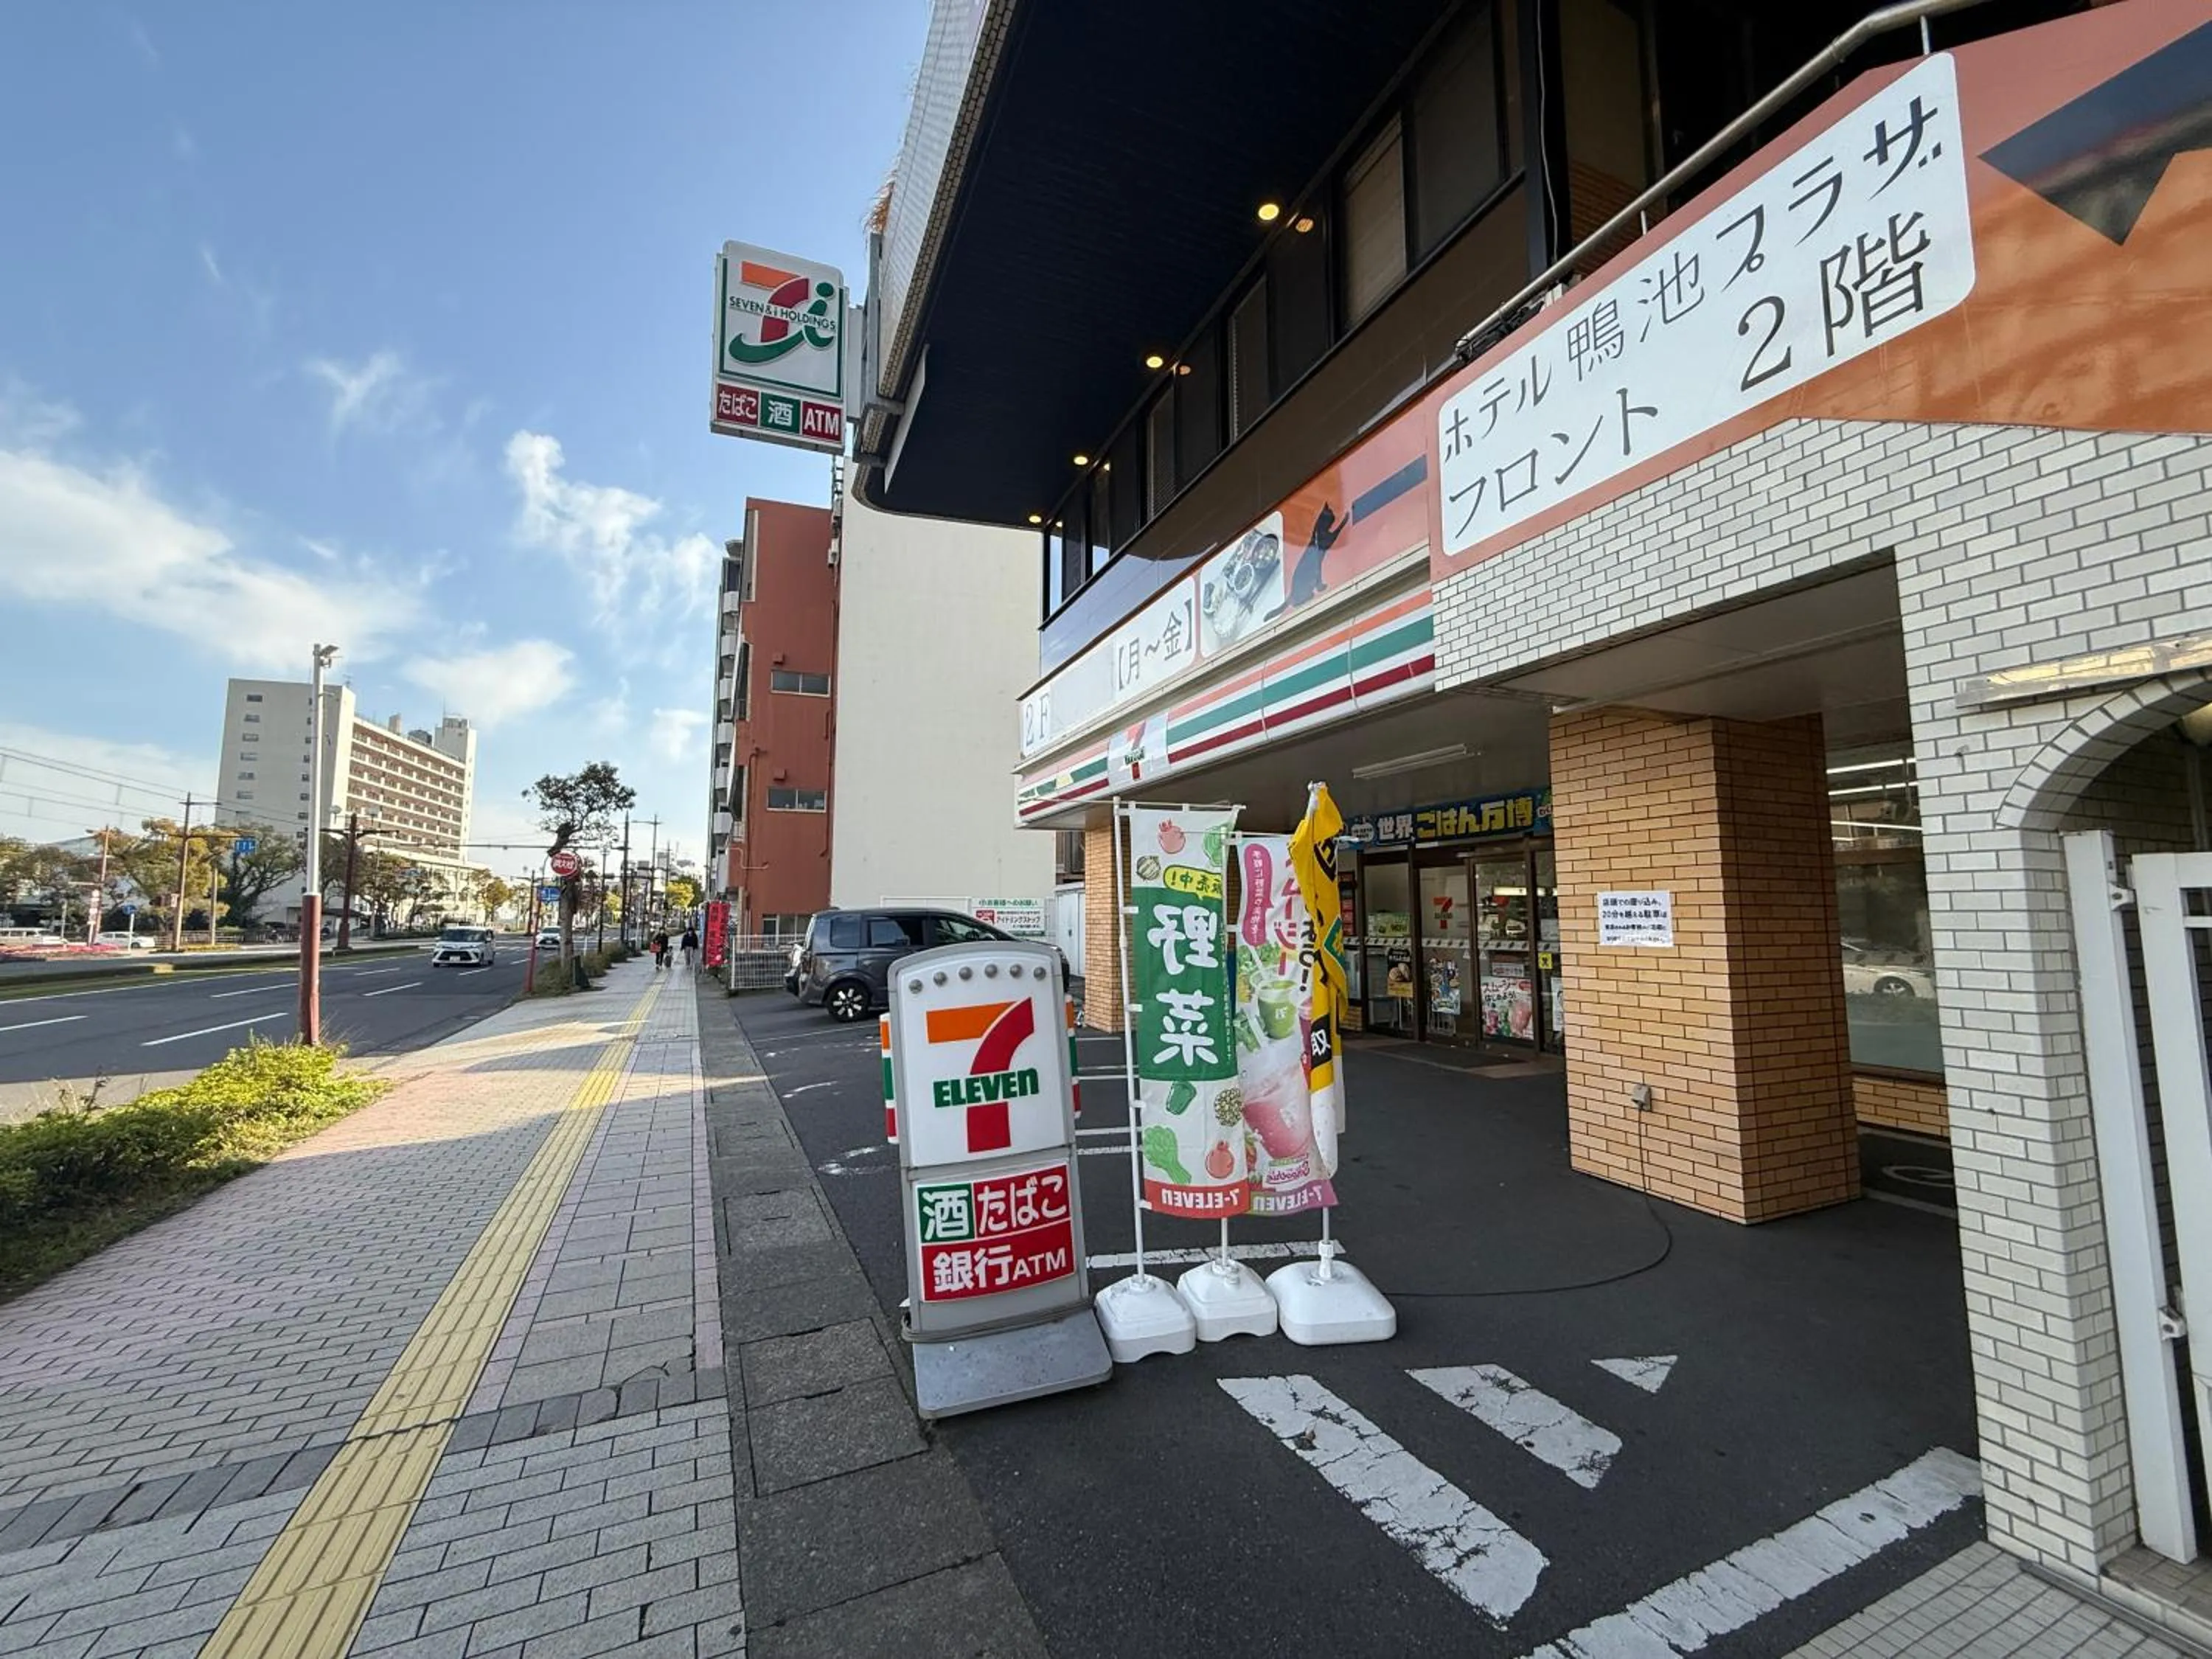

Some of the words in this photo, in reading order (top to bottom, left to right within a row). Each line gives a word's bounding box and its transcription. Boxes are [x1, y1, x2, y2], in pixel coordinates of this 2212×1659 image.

[781, 306, 835, 330] HOLDINGS
[1450, 388, 1658, 538] フロント
[1738, 211, 1930, 392] 2階
[719, 390, 757, 419] たばこ
[768, 400, 792, 427] 酒
[804, 408, 839, 436] ATM
[922, 1189, 969, 1242] 酒
[976, 1175, 1067, 1236] たばこ
